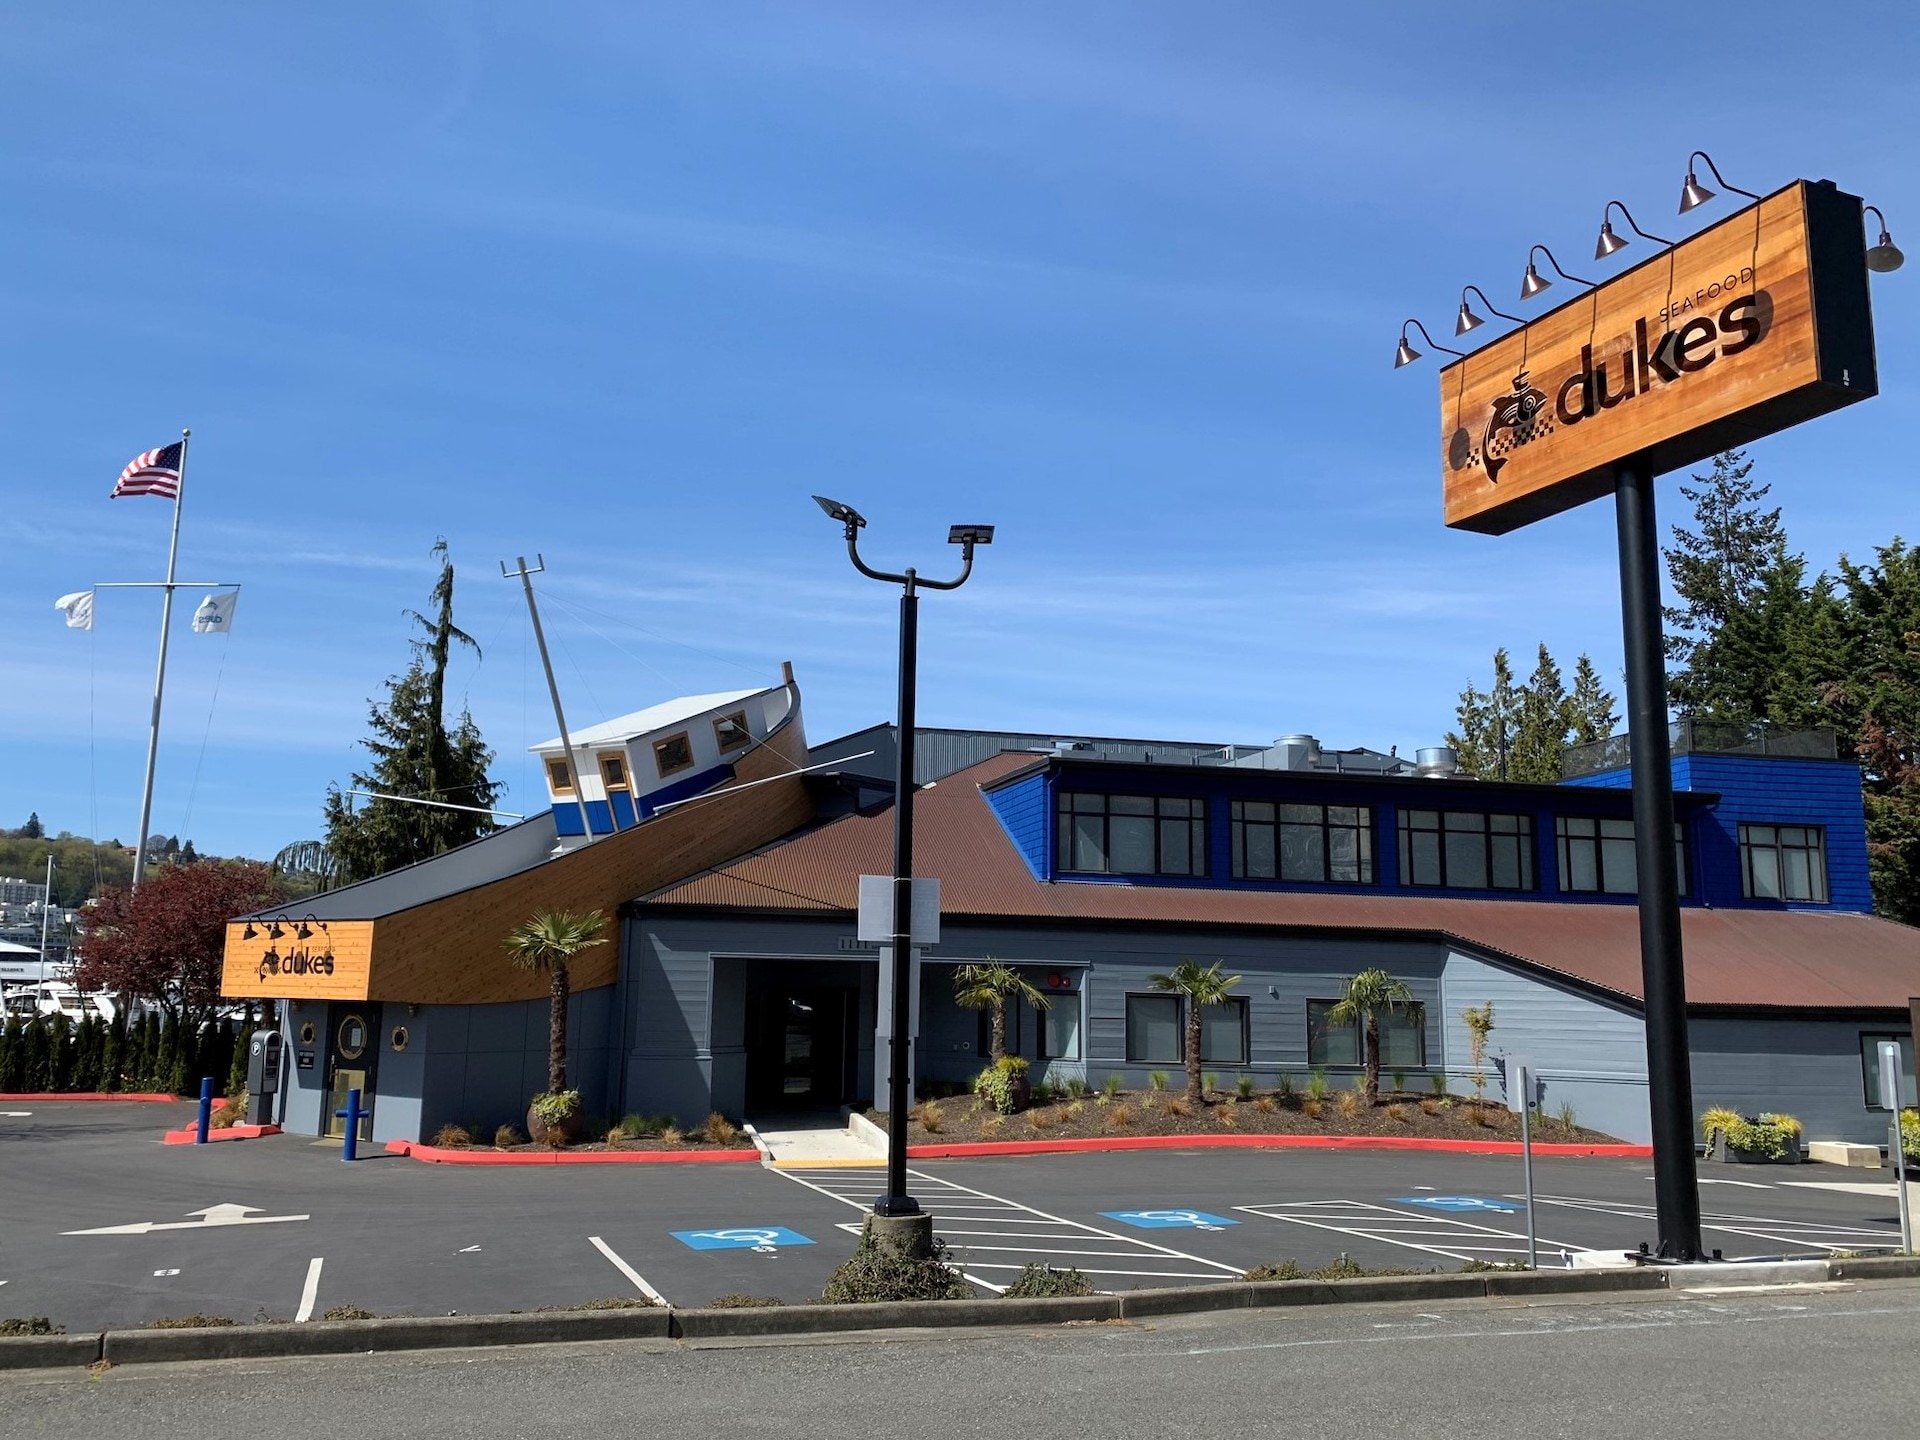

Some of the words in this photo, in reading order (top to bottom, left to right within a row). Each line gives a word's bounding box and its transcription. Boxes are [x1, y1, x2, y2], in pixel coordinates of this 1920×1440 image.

[1660, 267, 1753, 322] SEAFOOD
[1556, 294, 1760, 425] dukes
[282, 946, 334, 975] dukes
